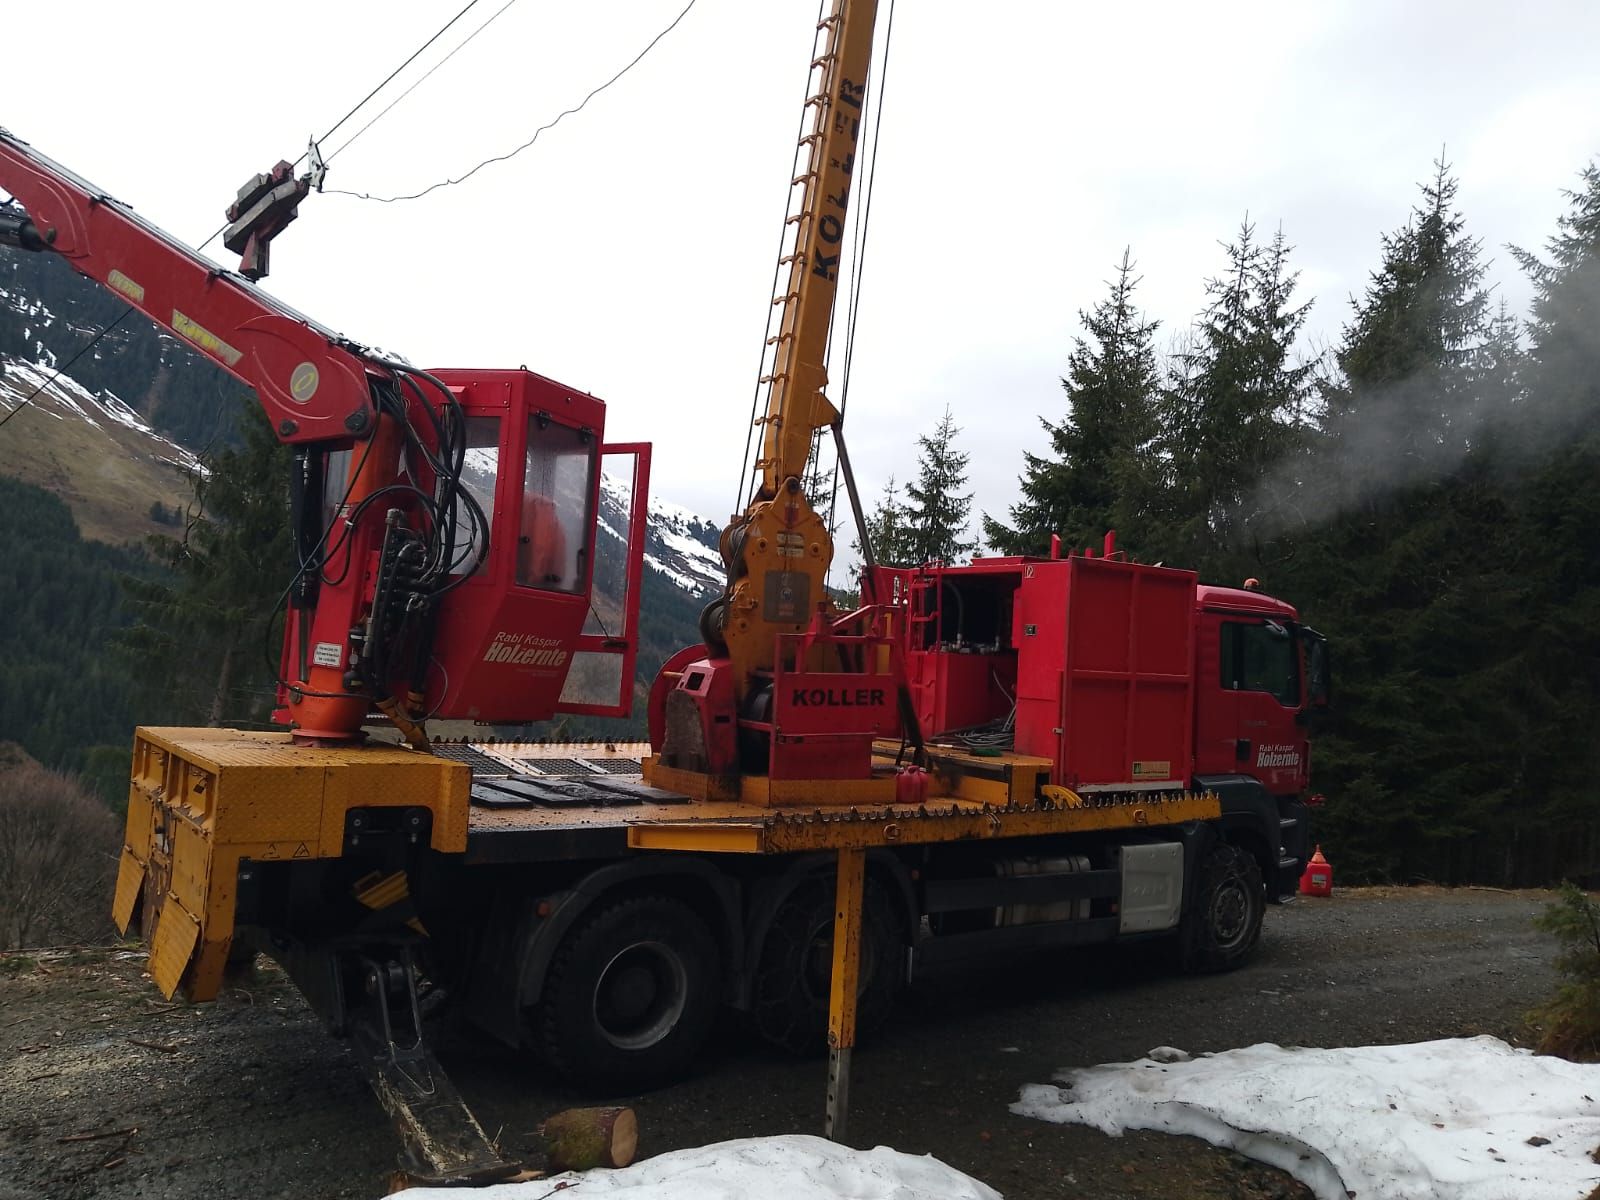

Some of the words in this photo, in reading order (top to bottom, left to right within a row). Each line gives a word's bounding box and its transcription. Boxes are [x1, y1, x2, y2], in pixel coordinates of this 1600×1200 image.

[494, 631, 524, 643] Rabl
[524, 634, 563, 648] Kaspar
[483, 641, 568, 667] Holzernte
[791, 688, 886, 706] KOLLER
[1260, 744, 1274, 752] Rabl
[1274, 743, 1295, 753] Kaspar
[1256, 751, 1299, 768] Holzernte
